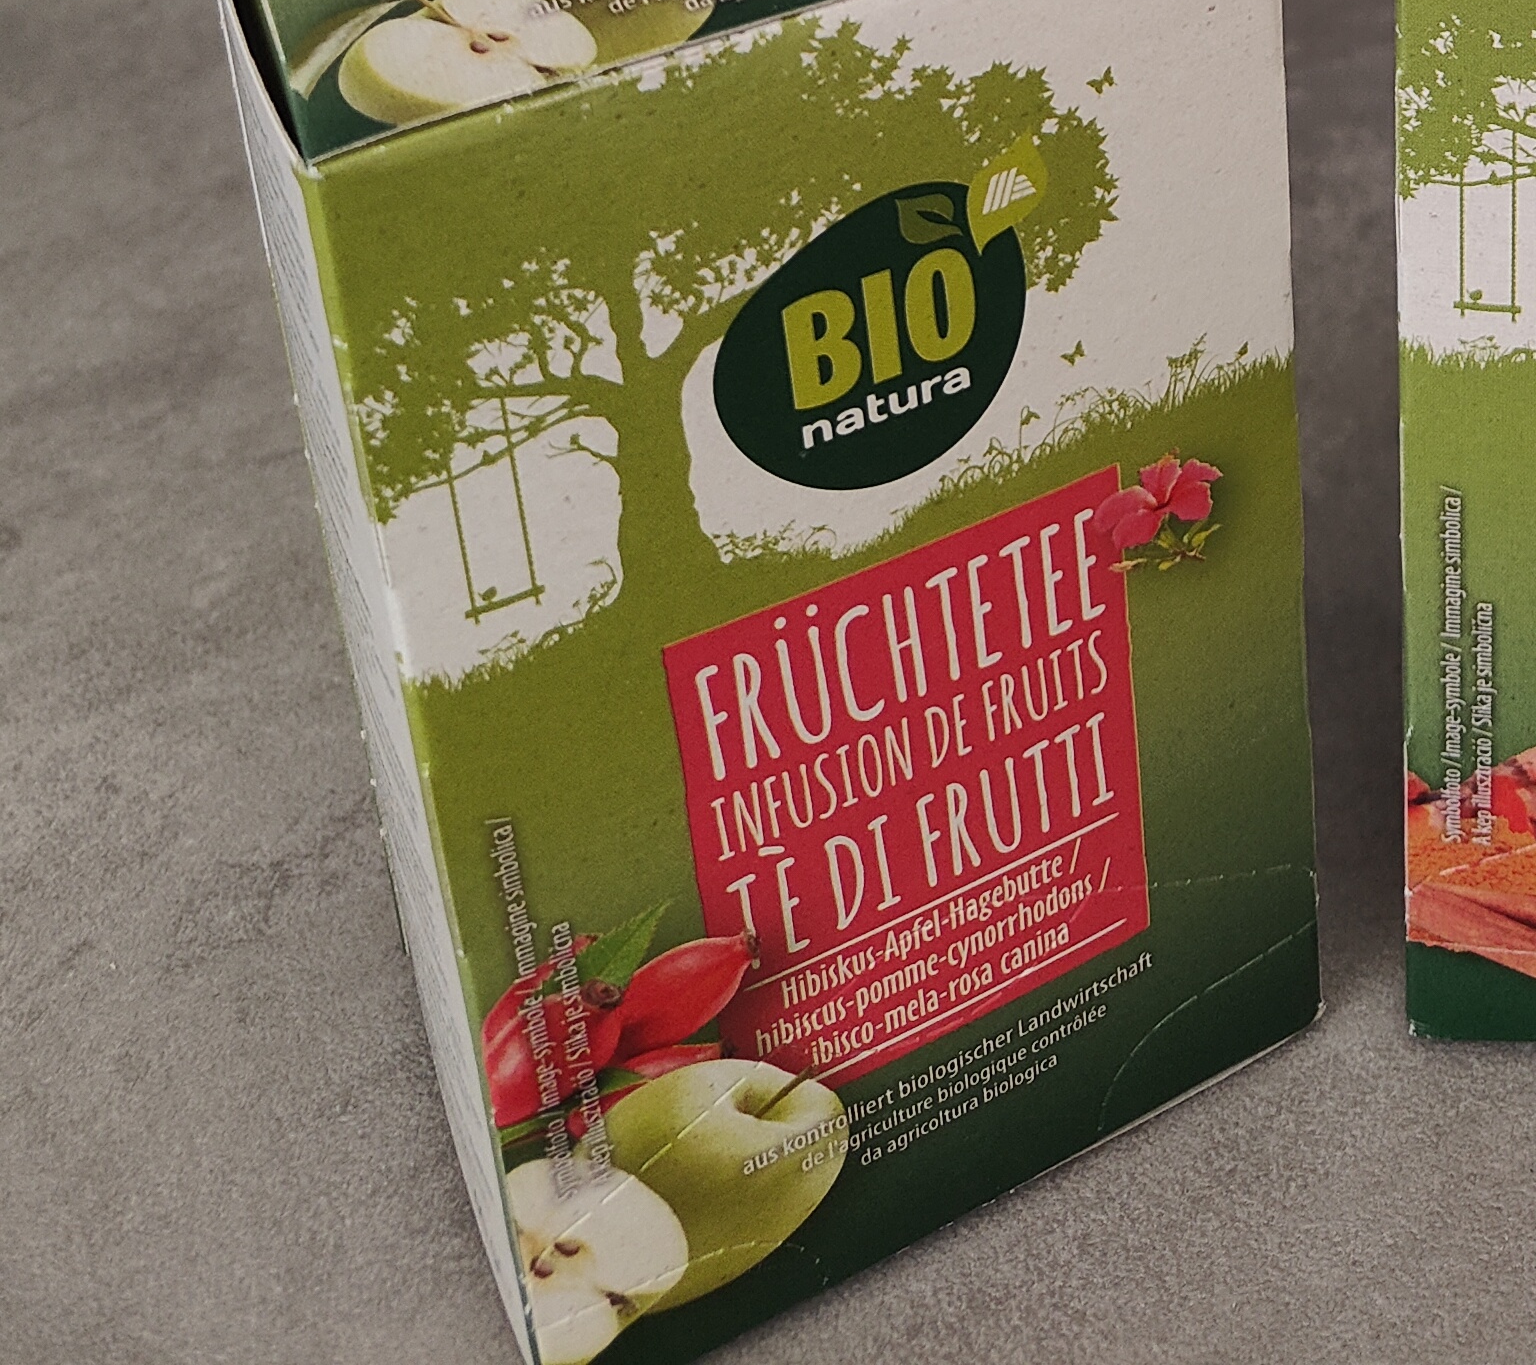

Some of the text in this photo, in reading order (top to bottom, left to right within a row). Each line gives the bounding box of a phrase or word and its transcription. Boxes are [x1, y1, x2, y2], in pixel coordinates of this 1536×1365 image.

[781, 247, 976, 410] BIO
[801, 365, 971, 450] natura
[1439, 497, 1462, 563] simbolica
[695, 508, 1107, 782] FRÜCHTETEE
[1440, 567, 1467, 638] Immagine
[1440, 653, 1467, 757] Image-symbole
[1472, 679, 1497, 694] je
[1472, 696, 1493, 727] Slika
[711, 629, 1109, 861] INFUSION DE FRUITS
[824, 814, 902, 931] DI
[915, 711, 1115, 889] FRUTTI
[1440, 769, 1466, 843] Symbolfoto
[490, 824, 521, 901] simbolica
[499, 892, 538, 983] Immagine
[755, 868, 1093, 1057] hibiscus-pomme-cynorrhodons
[780, 854, 1064, 1009] Hibiskus-Apfel-Hagebutte
[559, 1003, 590, 1021] je
[562, 1021, 591, 1062] Slika
[810, 922, 1071, 1066] ibisco-mela-rosa canina
[519, 999, 560, 1112] Image-symbole
[742, 952, 1153, 1176] aus kontrolliert biologischer Landwirtschaft
[801, 1003, 1108, 1173] de l'agriculture biologique contrôlée
[860, 1053, 1058, 1167] da agricoltura biologica
